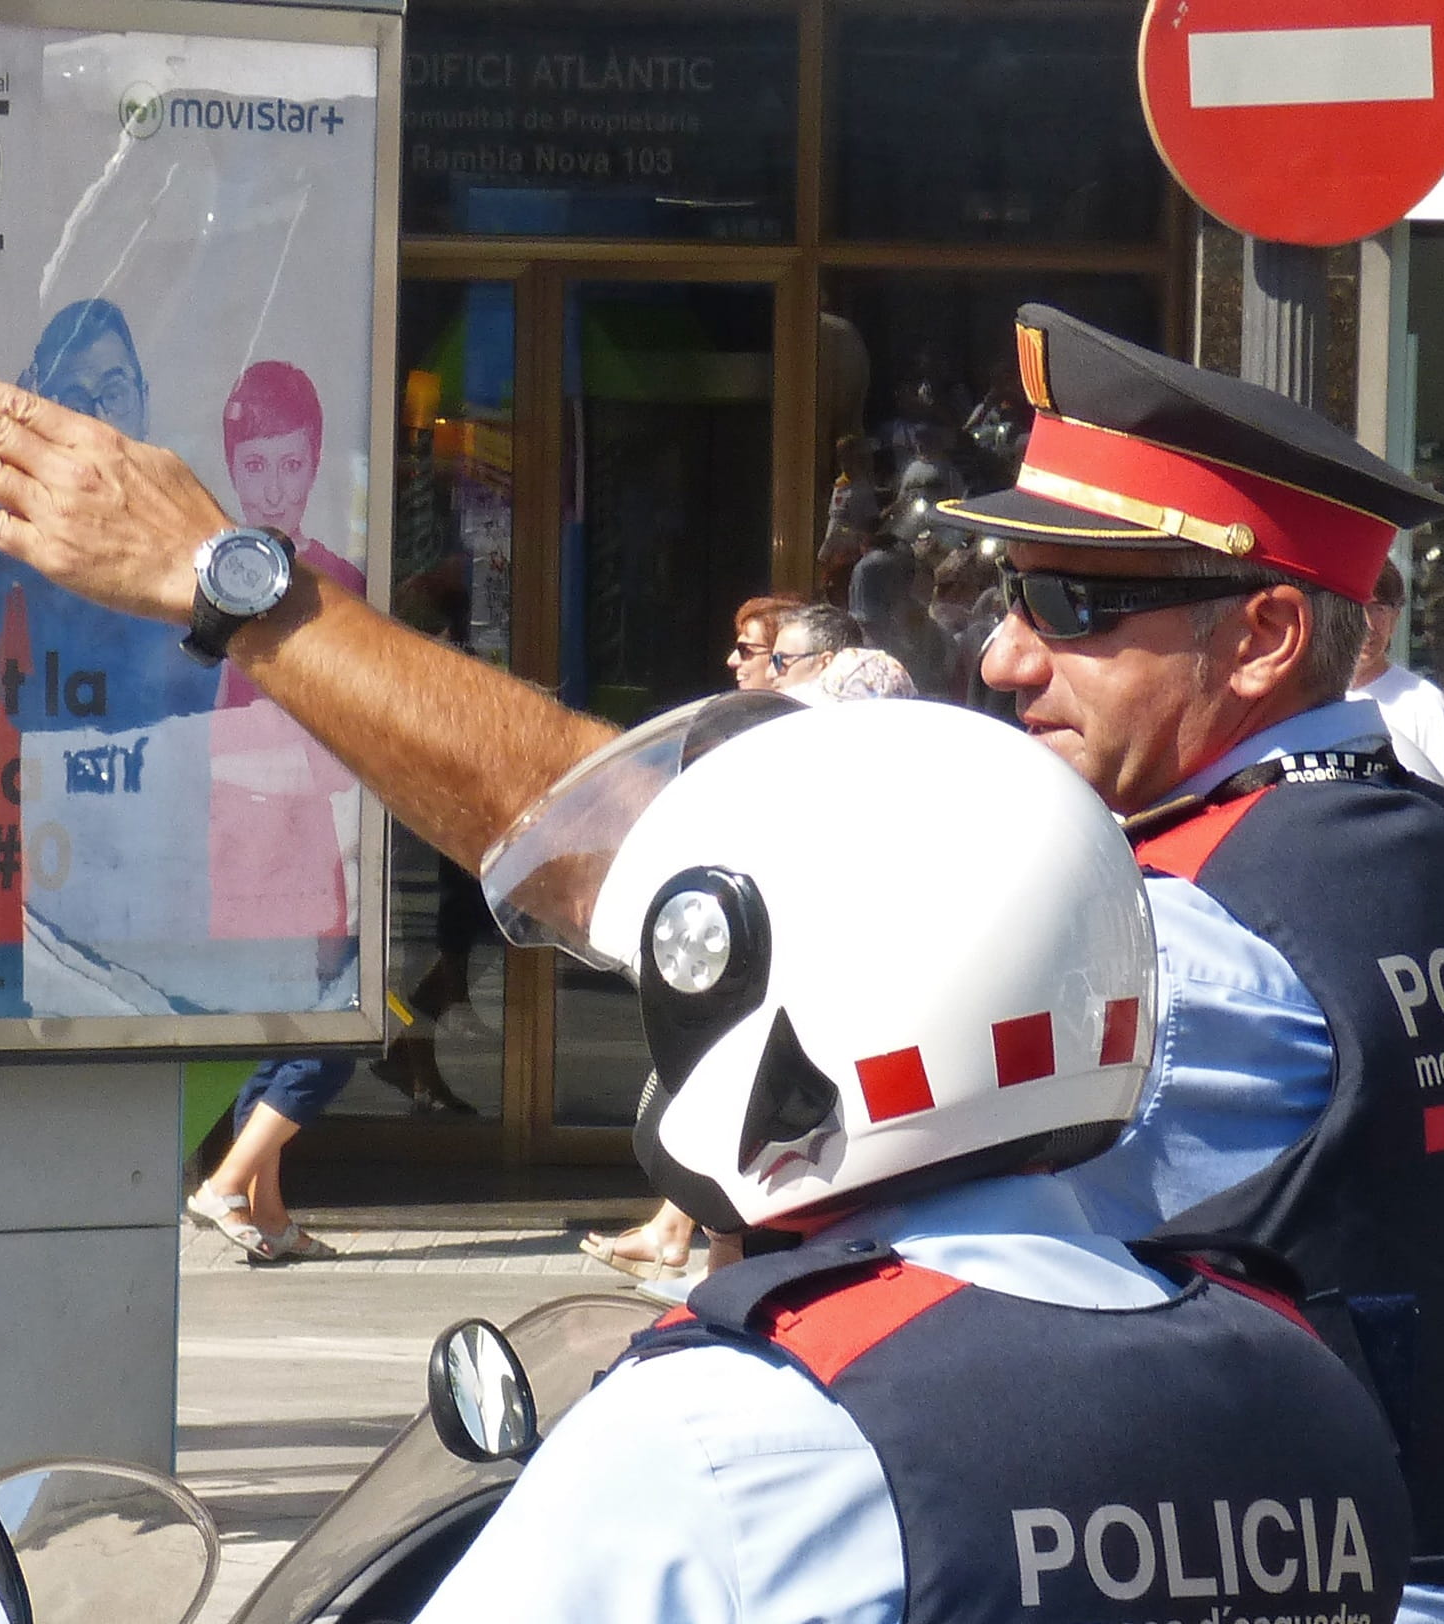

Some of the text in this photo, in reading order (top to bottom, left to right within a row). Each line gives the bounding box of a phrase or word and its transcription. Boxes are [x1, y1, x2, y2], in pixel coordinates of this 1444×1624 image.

[404, 54, 517, 90] DIFICI
[169, 97, 345, 137] movistar+
[535, 146, 611, 174] Nova
[44, 649, 108, 719] la
[1011, 1496, 1375, 1608] POLICIA
